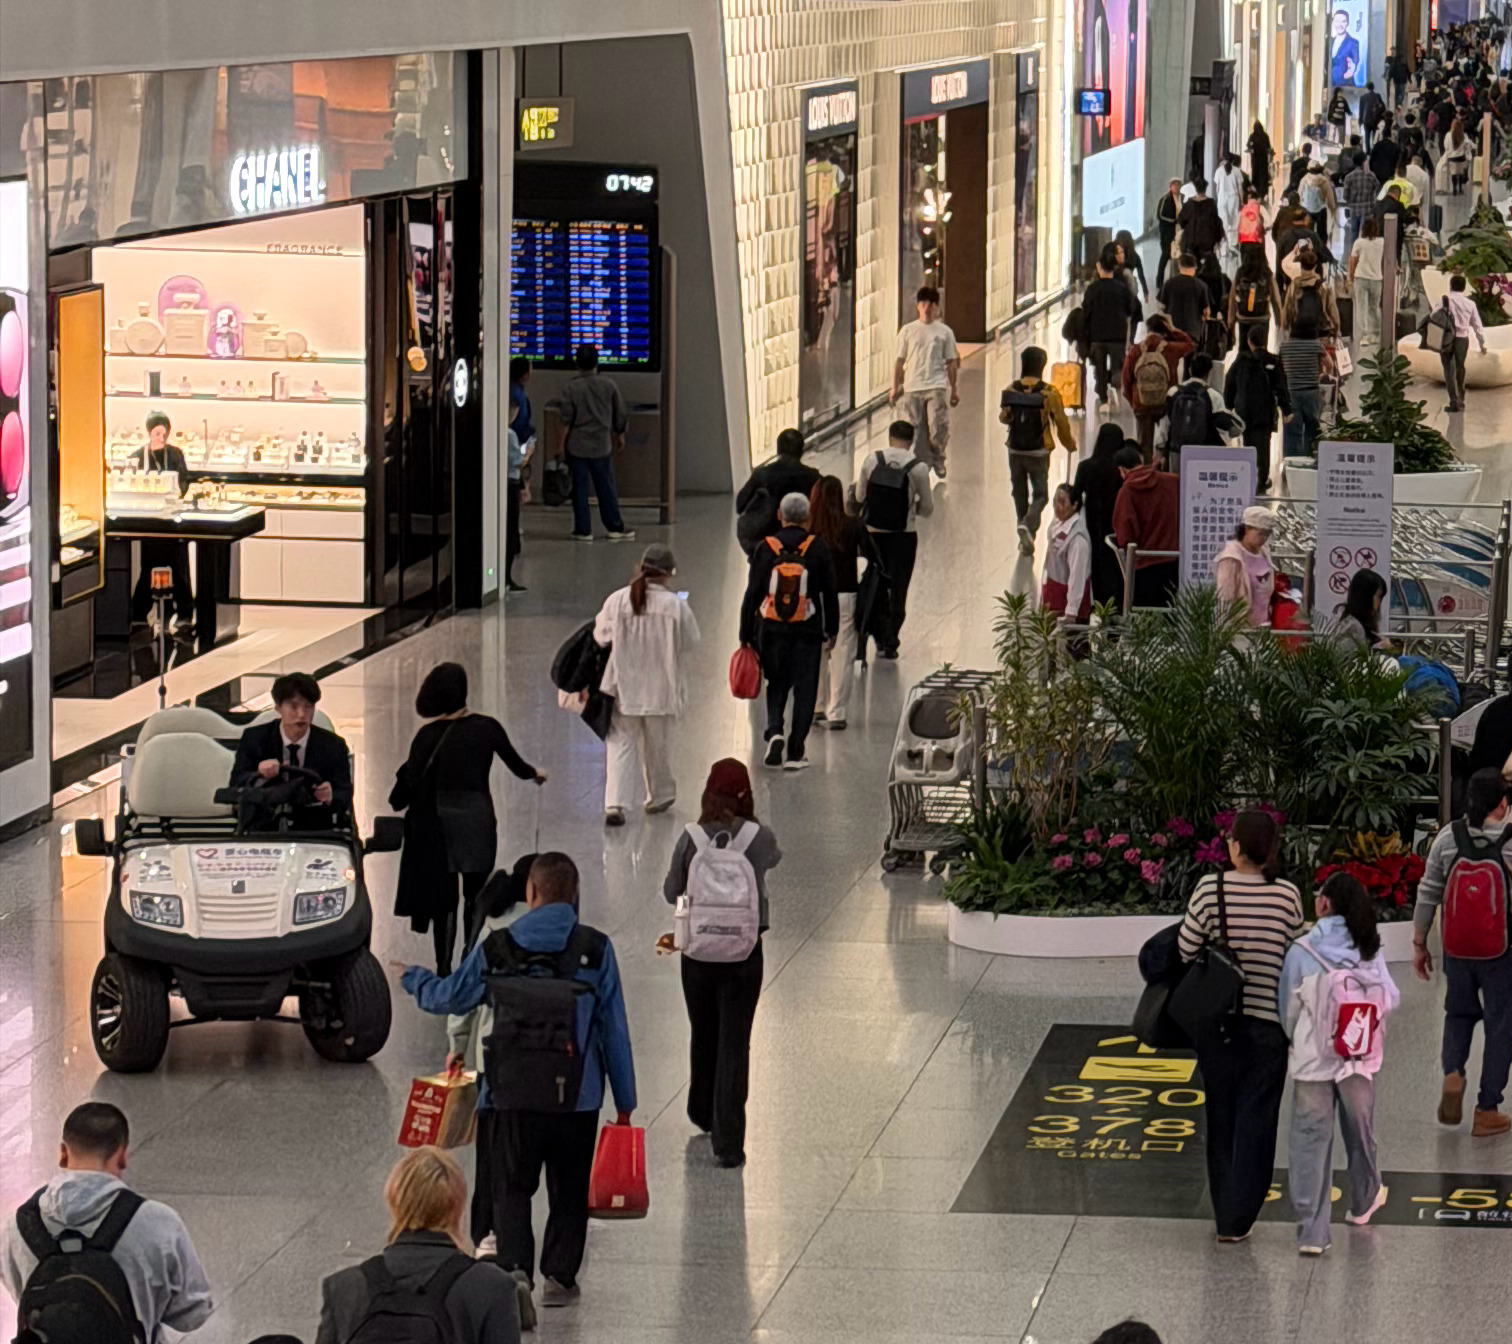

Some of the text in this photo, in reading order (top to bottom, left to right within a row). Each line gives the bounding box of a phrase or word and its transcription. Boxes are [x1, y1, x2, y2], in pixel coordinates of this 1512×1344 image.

[230, 146, 326, 213] CHANEL
[266, 243, 344, 256] FRAGRANCE
[1044, 1085, 1206, 1106] 320
[1027, 1115, 1196, 1137] 378
[1025, 1136, 1184, 1152] 登机口
[1057, 1150, 1142, 1160] Gates
